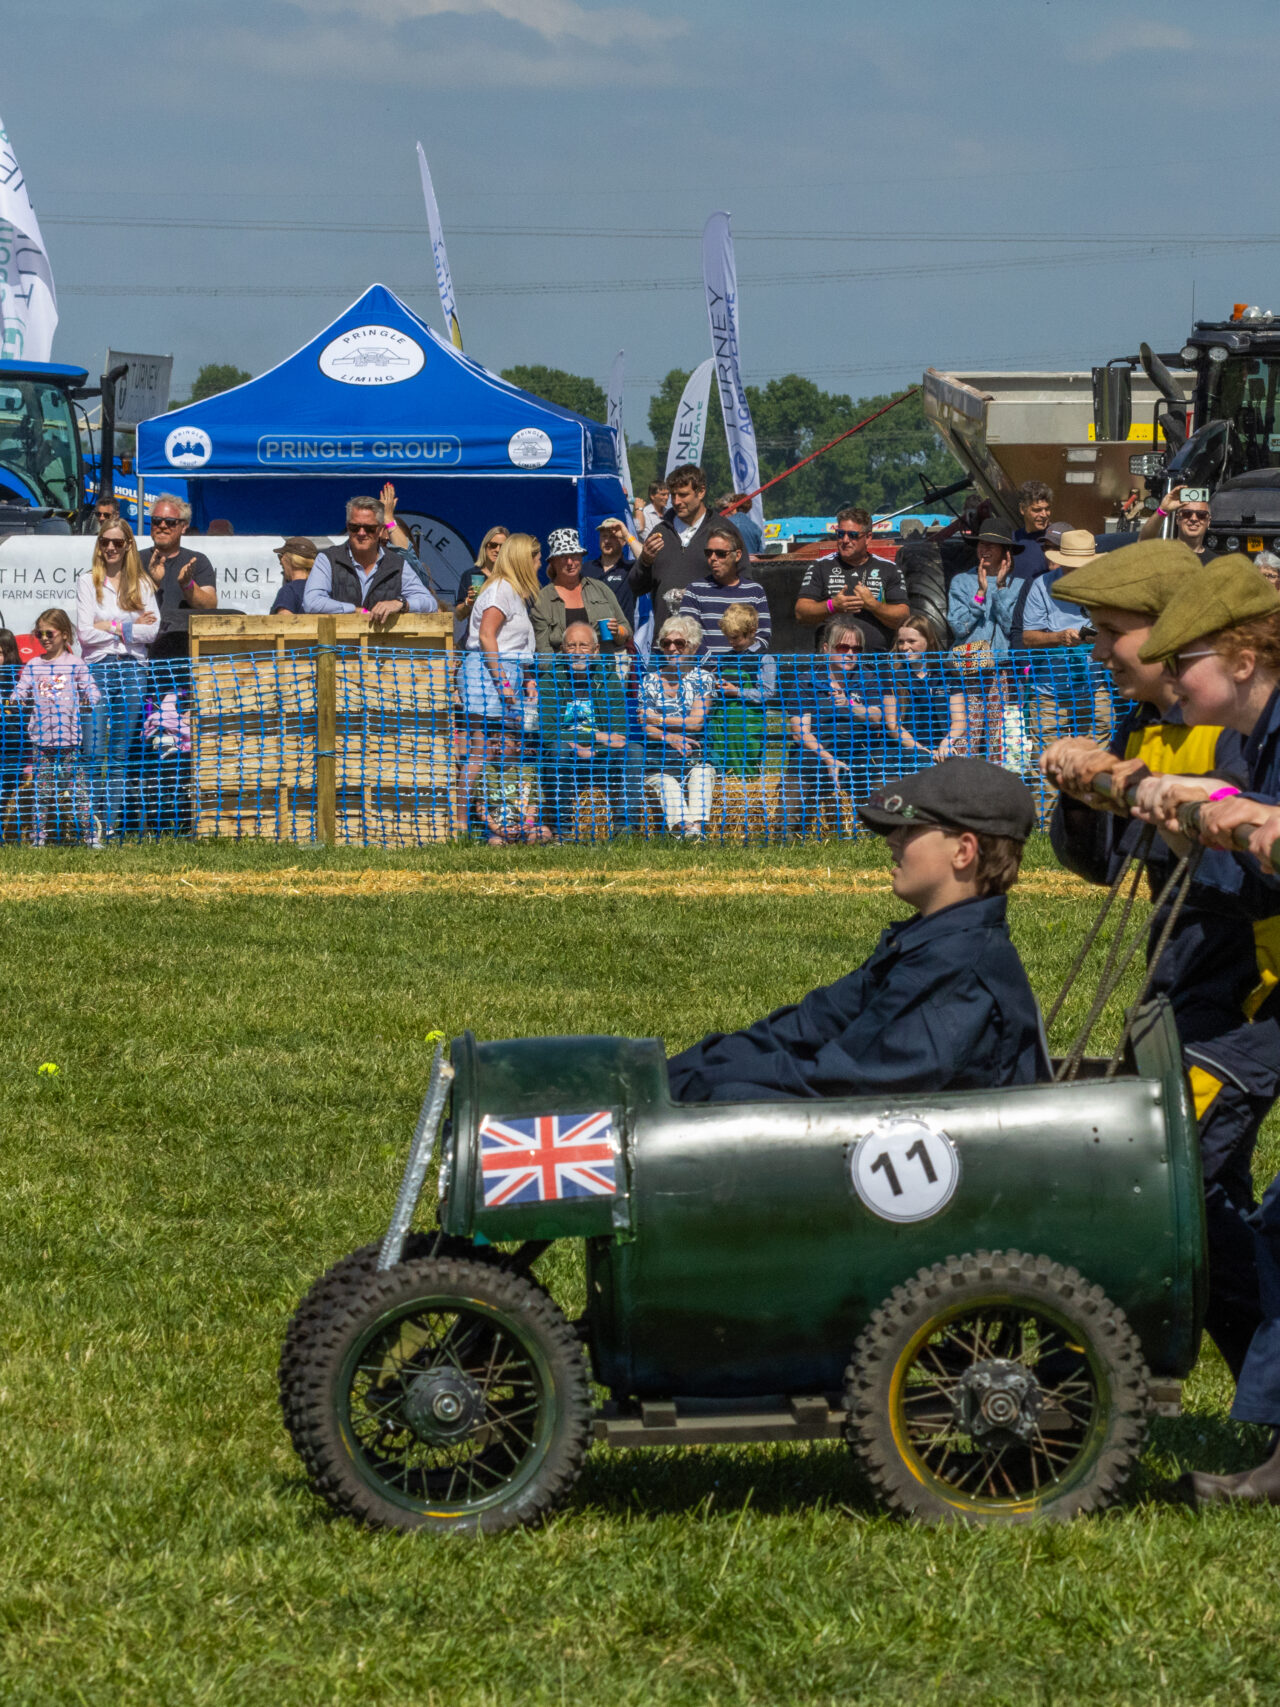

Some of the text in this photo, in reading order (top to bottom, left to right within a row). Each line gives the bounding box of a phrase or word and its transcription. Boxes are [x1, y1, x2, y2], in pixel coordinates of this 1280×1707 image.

[343, 329, 406, 344] PRINGLE
[340, 374, 395, 383] LIMING
[265, 441, 452, 459] PRINGLE GROUP
[2, 589, 33, 600] FARM
[870, 1138, 939, 1198] 11
